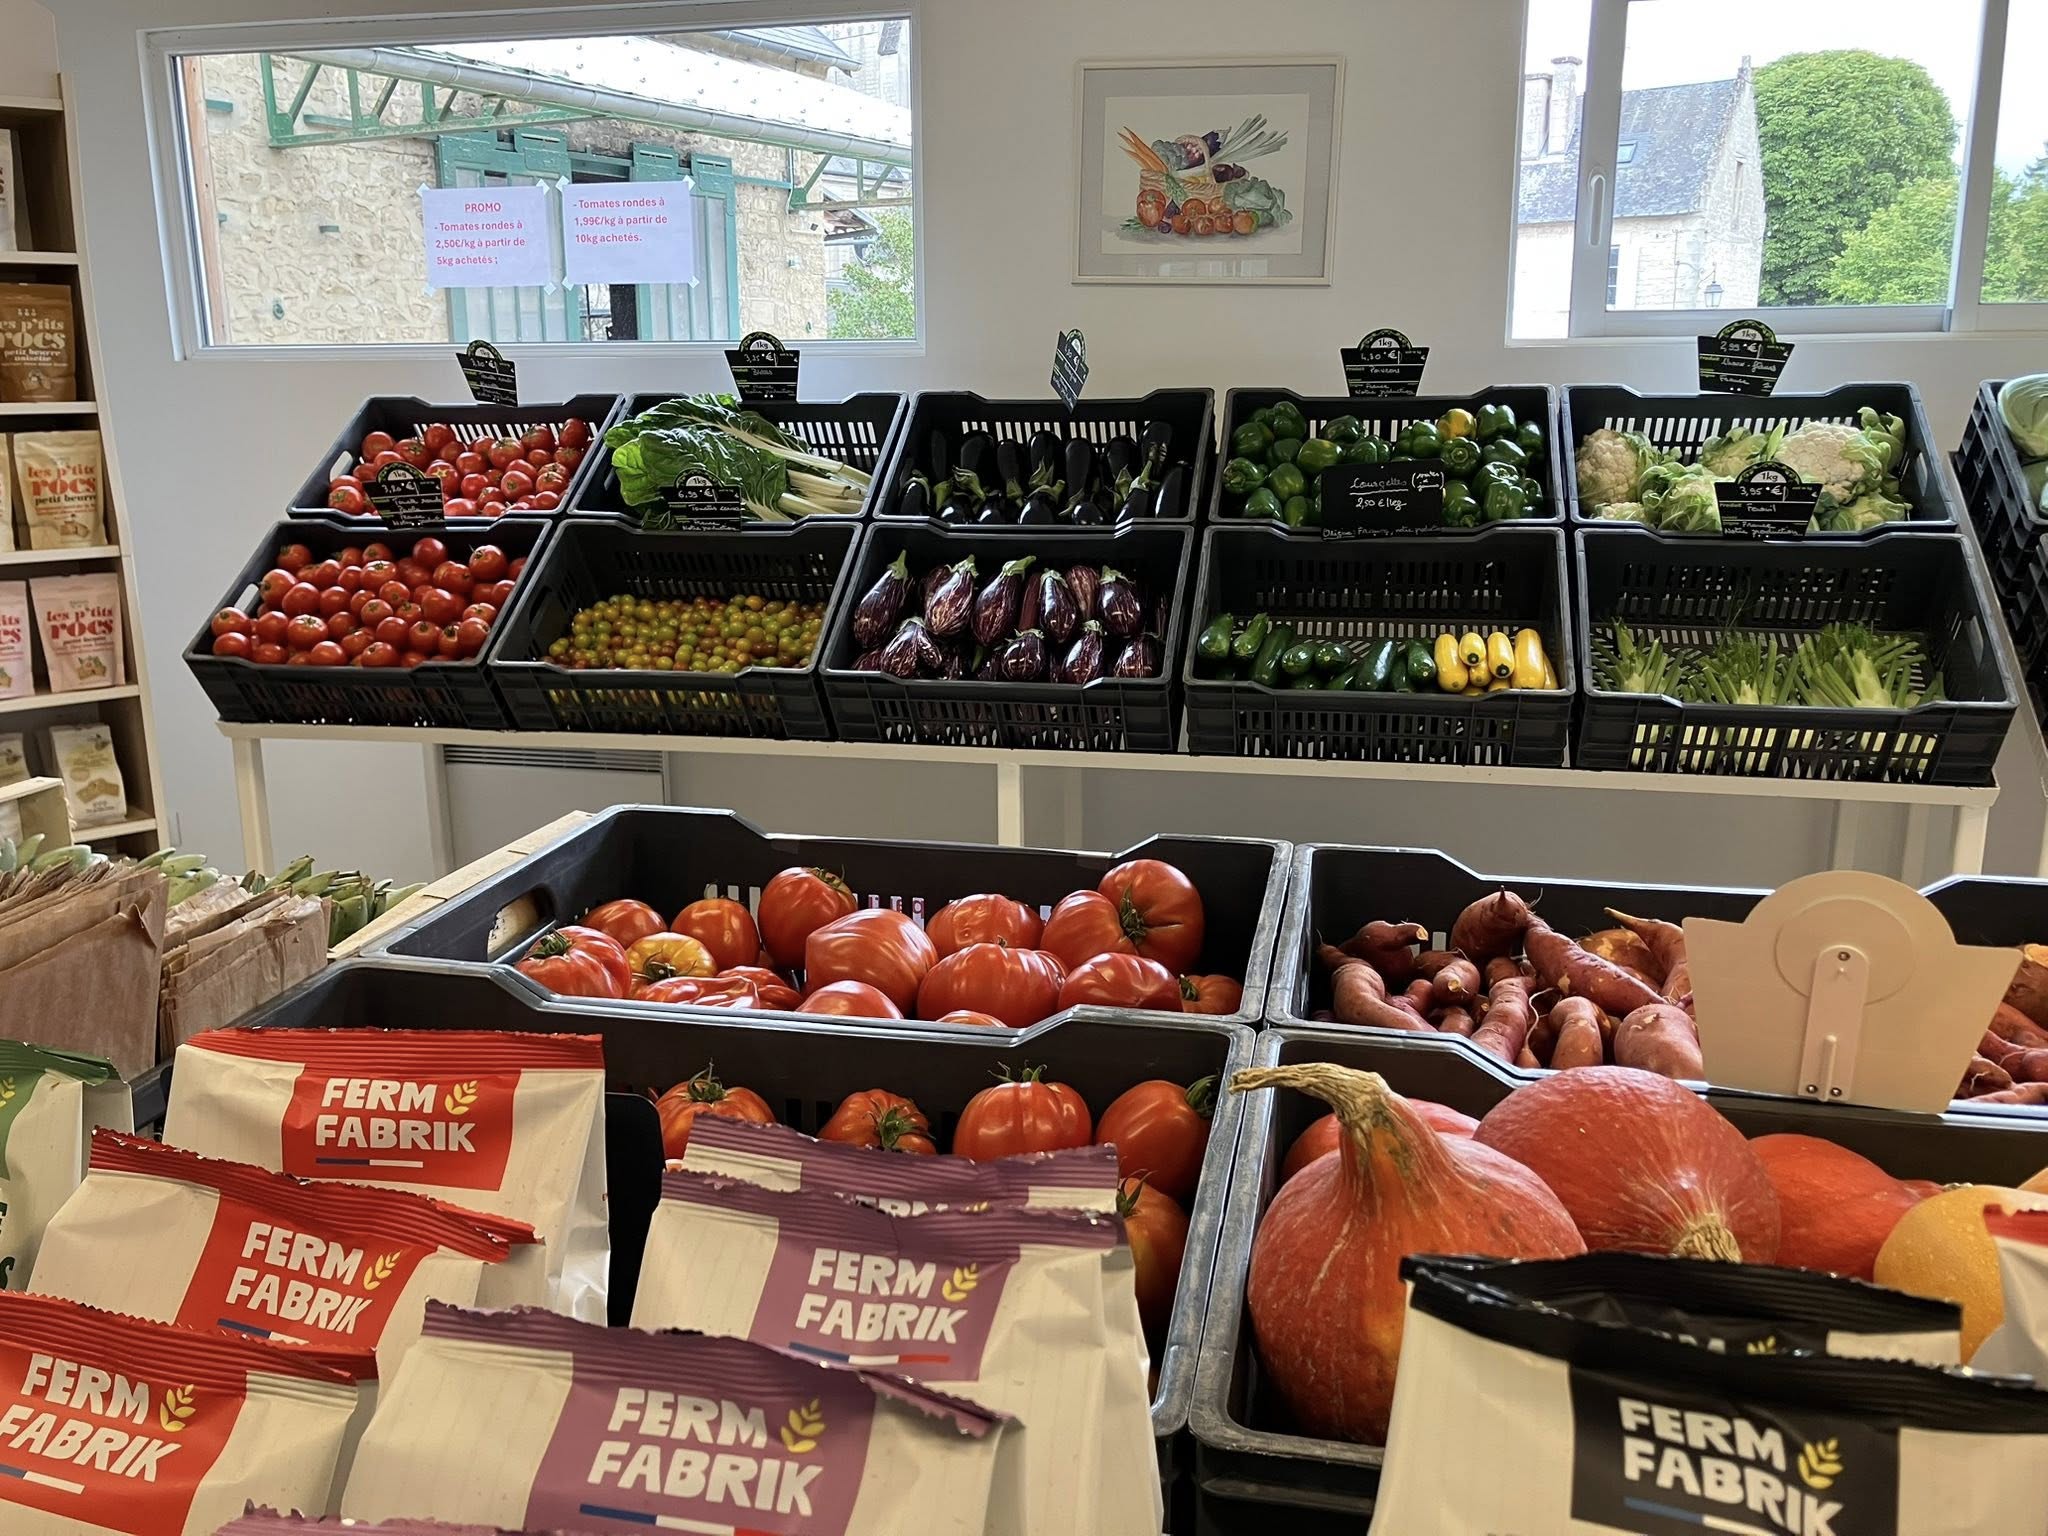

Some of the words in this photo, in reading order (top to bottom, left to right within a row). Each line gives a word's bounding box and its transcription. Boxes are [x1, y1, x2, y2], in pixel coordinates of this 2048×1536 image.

[464, 202, 501, 212] PROMO
[578, 198, 620, 209] Tomates
[622, 198, 656, 208] rondes
[659, 197, 665, 207] à
[440, 222, 479, 231] Tomates
[482, 221, 514, 230] rondes
[517, 220, 523, 230] à
[574, 215, 616, 226] 1,99€/kg
[618, 215, 624, 225] à
[626, 214, 653, 225] partir
[655, 214, 668, 224] de
[436, 238, 475, 249] 2,50€/kg
[477, 238, 483, 248] à
[485, 238, 511, 248] partir
[513, 237, 525, 246] de
[576, 234, 598, 245] 10kg
[600, 232, 642, 243] achetés.
[437, 256, 454, 266] 5kg
[455, 254, 493, 265] achetés
[1742, 330, 1757, 339] 1kg
[756, 341, 769, 349] 1kg
[1378, 339, 1393, 347] 1kg
[1762, 472, 1778, 481] 1kg
[1740, 487, 1762, 496] 3,95
[1356, 497, 1374, 510] 2,50
[51, 619, 113, 639] rocs
[321, 1077, 437, 1114] FERM
[315, 1116, 476, 1153] FABRIK
[240, 1222, 365, 1286] FERM
[807, 1247, 937, 1300] FERM
[224, 1266, 374, 1334] FABRIK
[795, 1293, 969, 1345] FABRIK
[20, 1353, 150, 1425] FERM
[607, 1387, 768, 1449] FERM
[1618, 1397, 1787, 1471] FERM
[0, 1404, 182, 1482] FABRIK
[586, 1440, 824, 1517] FABRIK
[1622, 1436, 1845, 1536] FABRIK
